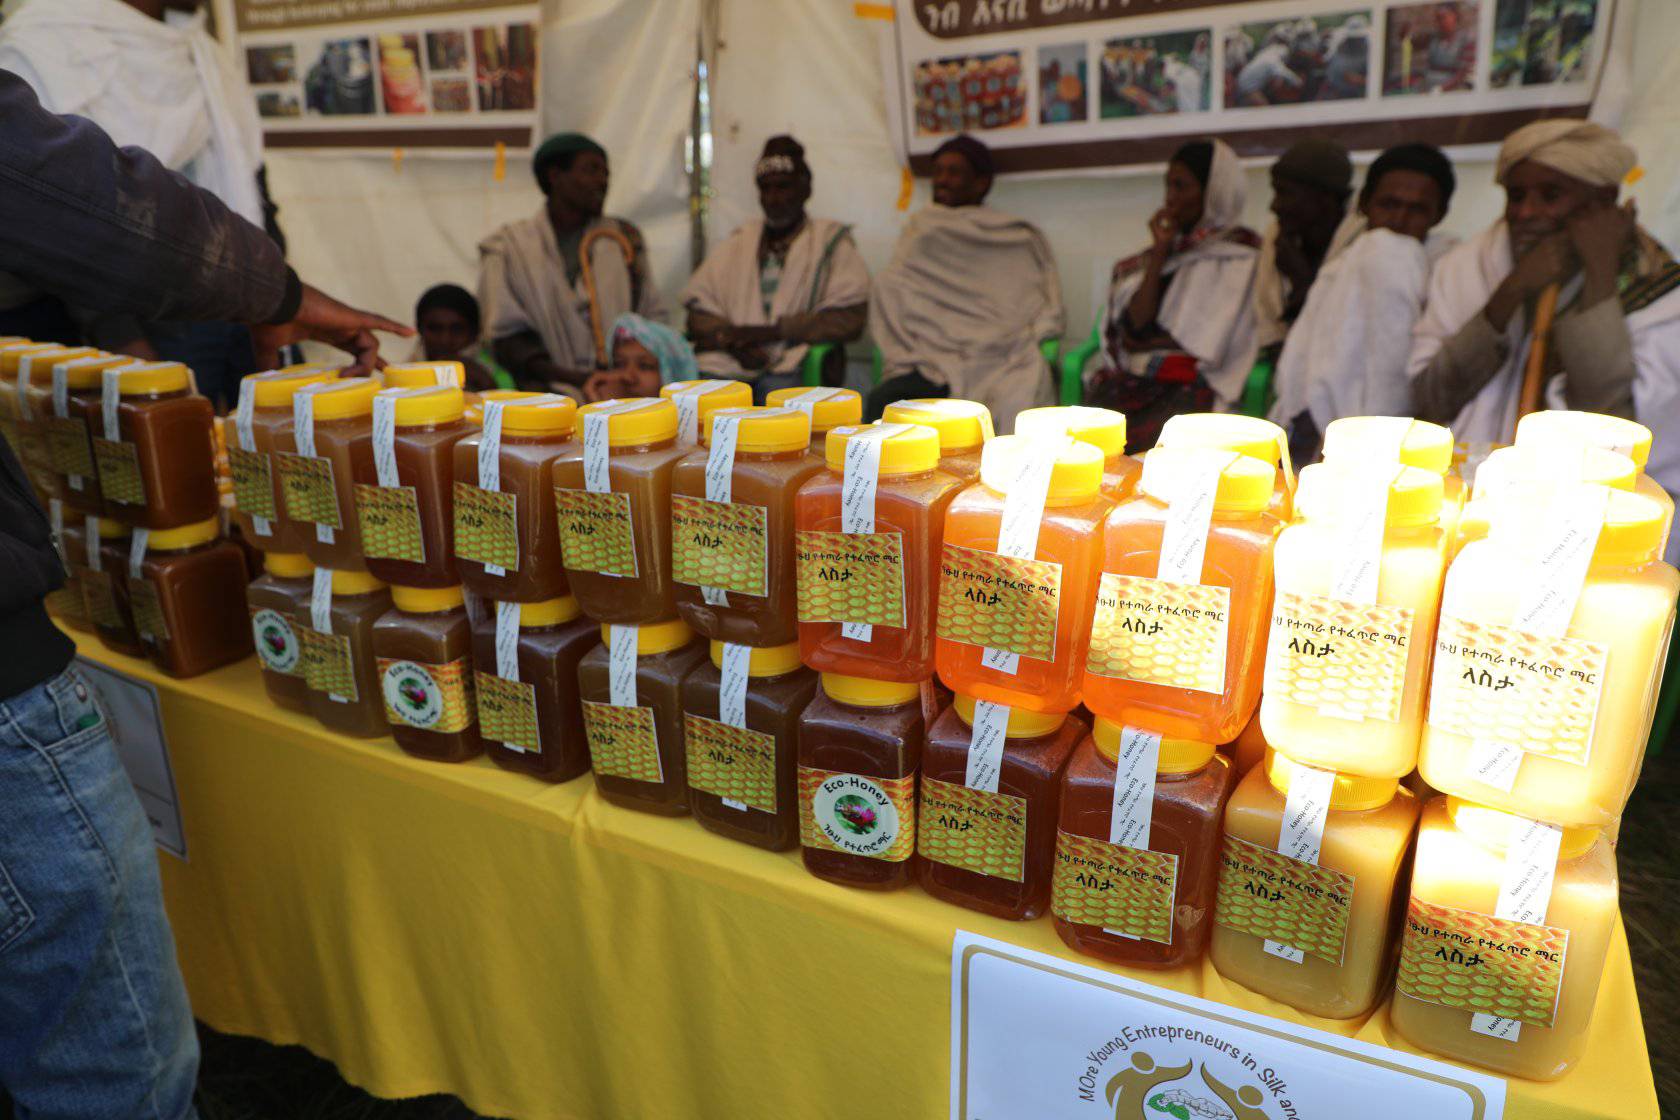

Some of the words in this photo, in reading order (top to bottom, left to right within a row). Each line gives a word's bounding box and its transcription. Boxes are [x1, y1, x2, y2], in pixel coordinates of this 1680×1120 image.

[818, 566, 854, 583] ላስታ
[962, 571, 994, 584] የተጣራ
[995, 577, 1036, 593] የተፈጥሮ
[1038, 585, 1057, 598] ማር
[964, 586, 1002, 607] ላስታ
[1119, 600, 1154, 613] የተጣራ
[1157, 604, 1202, 620] የተፈጥሮ
[1204, 610, 1225, 623] ማር
[1121, 617, 1164, 637] ላስታ
[1286, 617, 1326, 634] የተጣራ
[1329, 625, 1380, 643] የተፈጥሮ
[1383, 633, 1407, 647] ማር
[1287, 636, 1336, 659] ላስታ
[1461, 646, 1505, 665] የተጣራ
[1509, 657, 1566, 680] የተፈጥሮ
[1569, 668, 1598, 686] ማር
[1462, 667, 1516, 692] ላስታ
[823, 776, 890, 808] Eco-Honey
[1117, 776, 1140, 809] Eco-Honey
[938, 814, 974, 832] ላስታ
[1289, 799, 1316, 830] Eco-Honey
[1075, 872, 1115, 892] ላስታ
[1242, 864, 1277, 882] የተጣራ
[1280, 876, 1324, 898] የተፈጥሮ
[1327, 891, 1347, 907] ማር
[1244, 880, 1286, 902] ላስታ
[1433, 927, 1475, 945] የተጣራ
[1478, 938, 1532, 958] የተፈጥሮ
[1535, 949, 1560, 964] ማር
[1434, 946, 1486, 968] ላስታ
[1087, 1036, 1129, 1067] Young
[1121, 1024, 1241, 1061] Entrepreneurs
[1240, 1052, 1258, 1072] in
[1077, 1064, 1100, 1103] MOre
[1256, 1067, 1287, 1098] Silk
